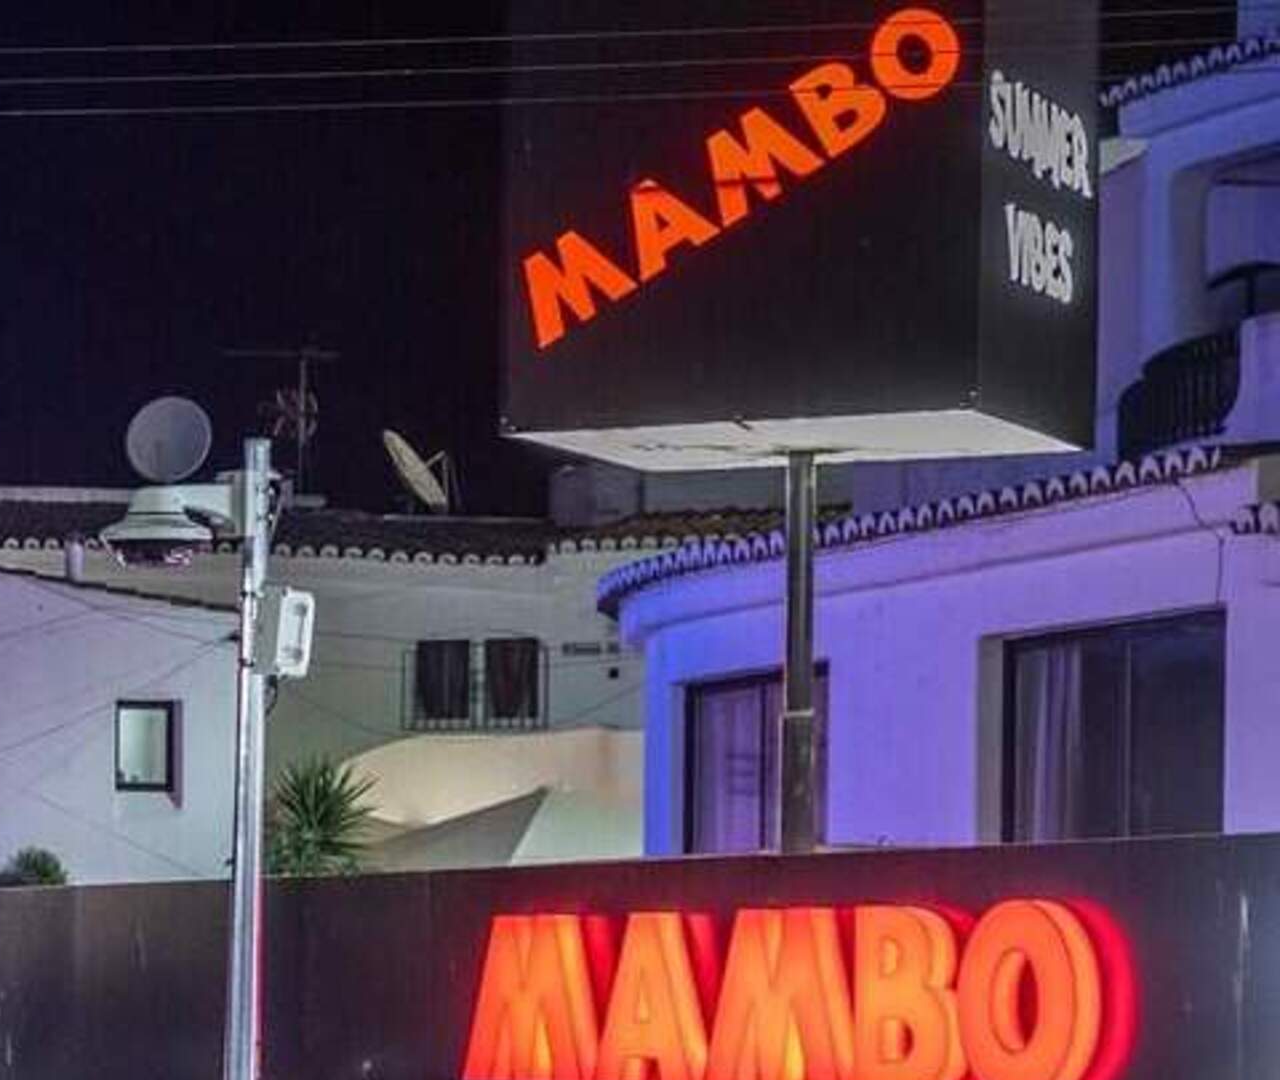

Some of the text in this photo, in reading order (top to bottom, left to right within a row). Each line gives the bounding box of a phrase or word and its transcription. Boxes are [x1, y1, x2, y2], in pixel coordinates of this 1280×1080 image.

[520, 8, 961, 348] MAMBO
[989, 69, 1092, 198] SUMMER
[1004, 203, 1073, 304] VIBES
